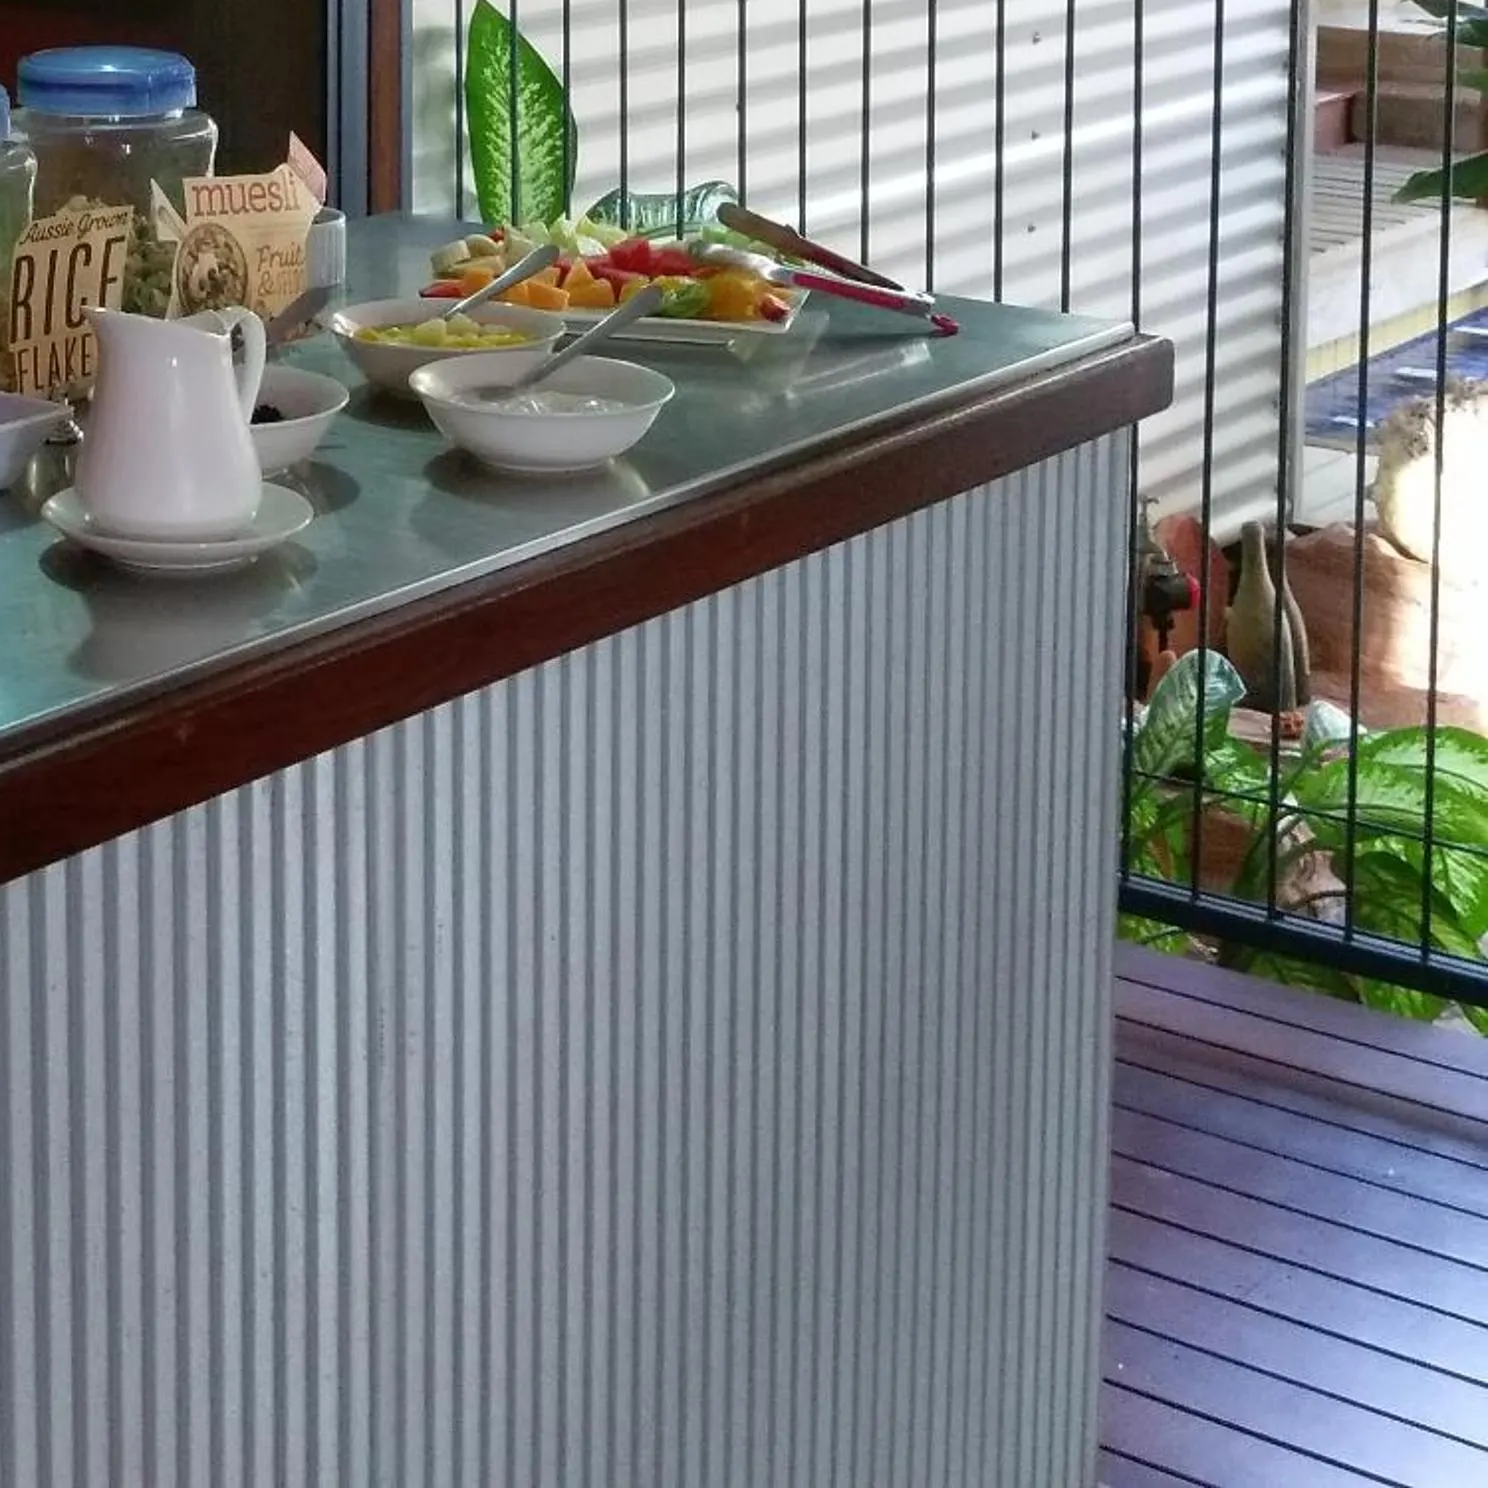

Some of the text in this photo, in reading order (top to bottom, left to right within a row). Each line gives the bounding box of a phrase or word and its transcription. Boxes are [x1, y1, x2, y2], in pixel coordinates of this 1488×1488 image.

[191, 168, 301, 217] muesli
[19, 217, 74, 245] Aussie
[255, 241, 301, 273] Fruit
[10, 235, 126, 345] RICE
